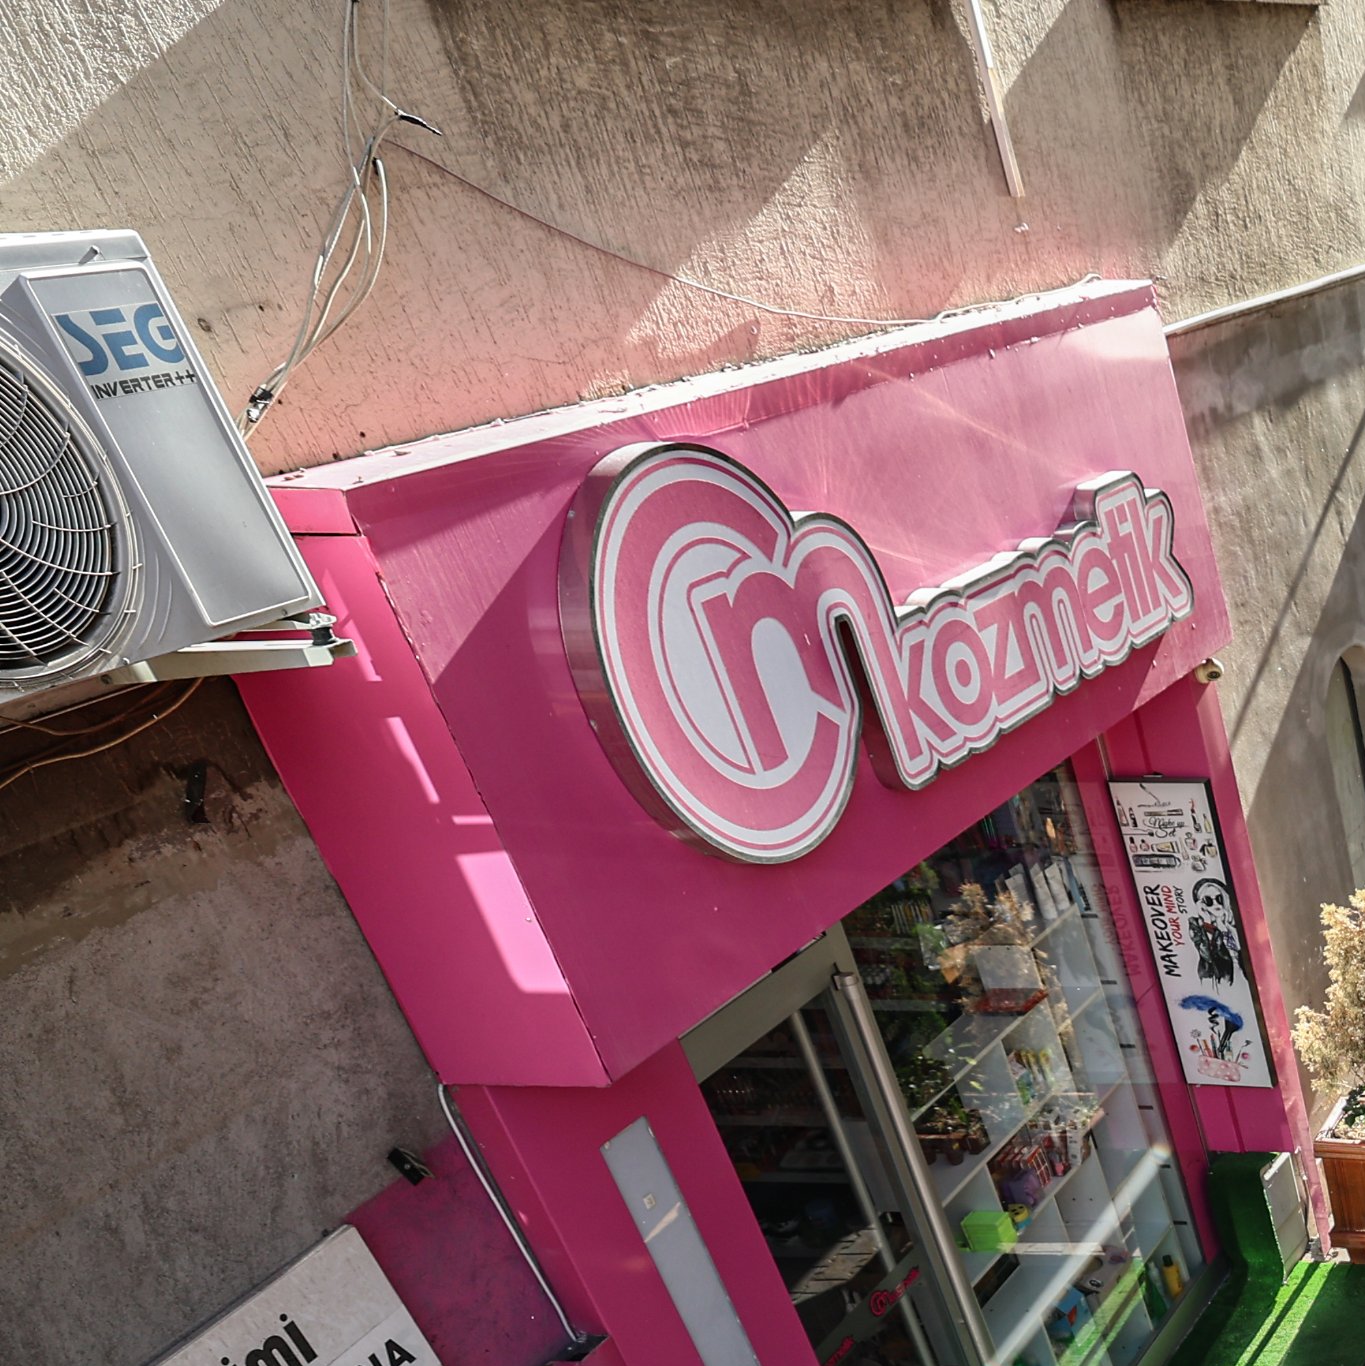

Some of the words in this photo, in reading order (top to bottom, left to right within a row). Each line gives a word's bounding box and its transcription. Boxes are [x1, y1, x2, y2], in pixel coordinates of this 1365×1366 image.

[55, 303, 185, 376] SEG
[893, 490, 1187, 768] kozmetik
[1161, 885, 1178, 914] MIND
[1173, 887, 1187, 914] STORY
[1143, 884, 1182, 977] MAKEOVER
[1171, 917, 1185, 946] YOUR
